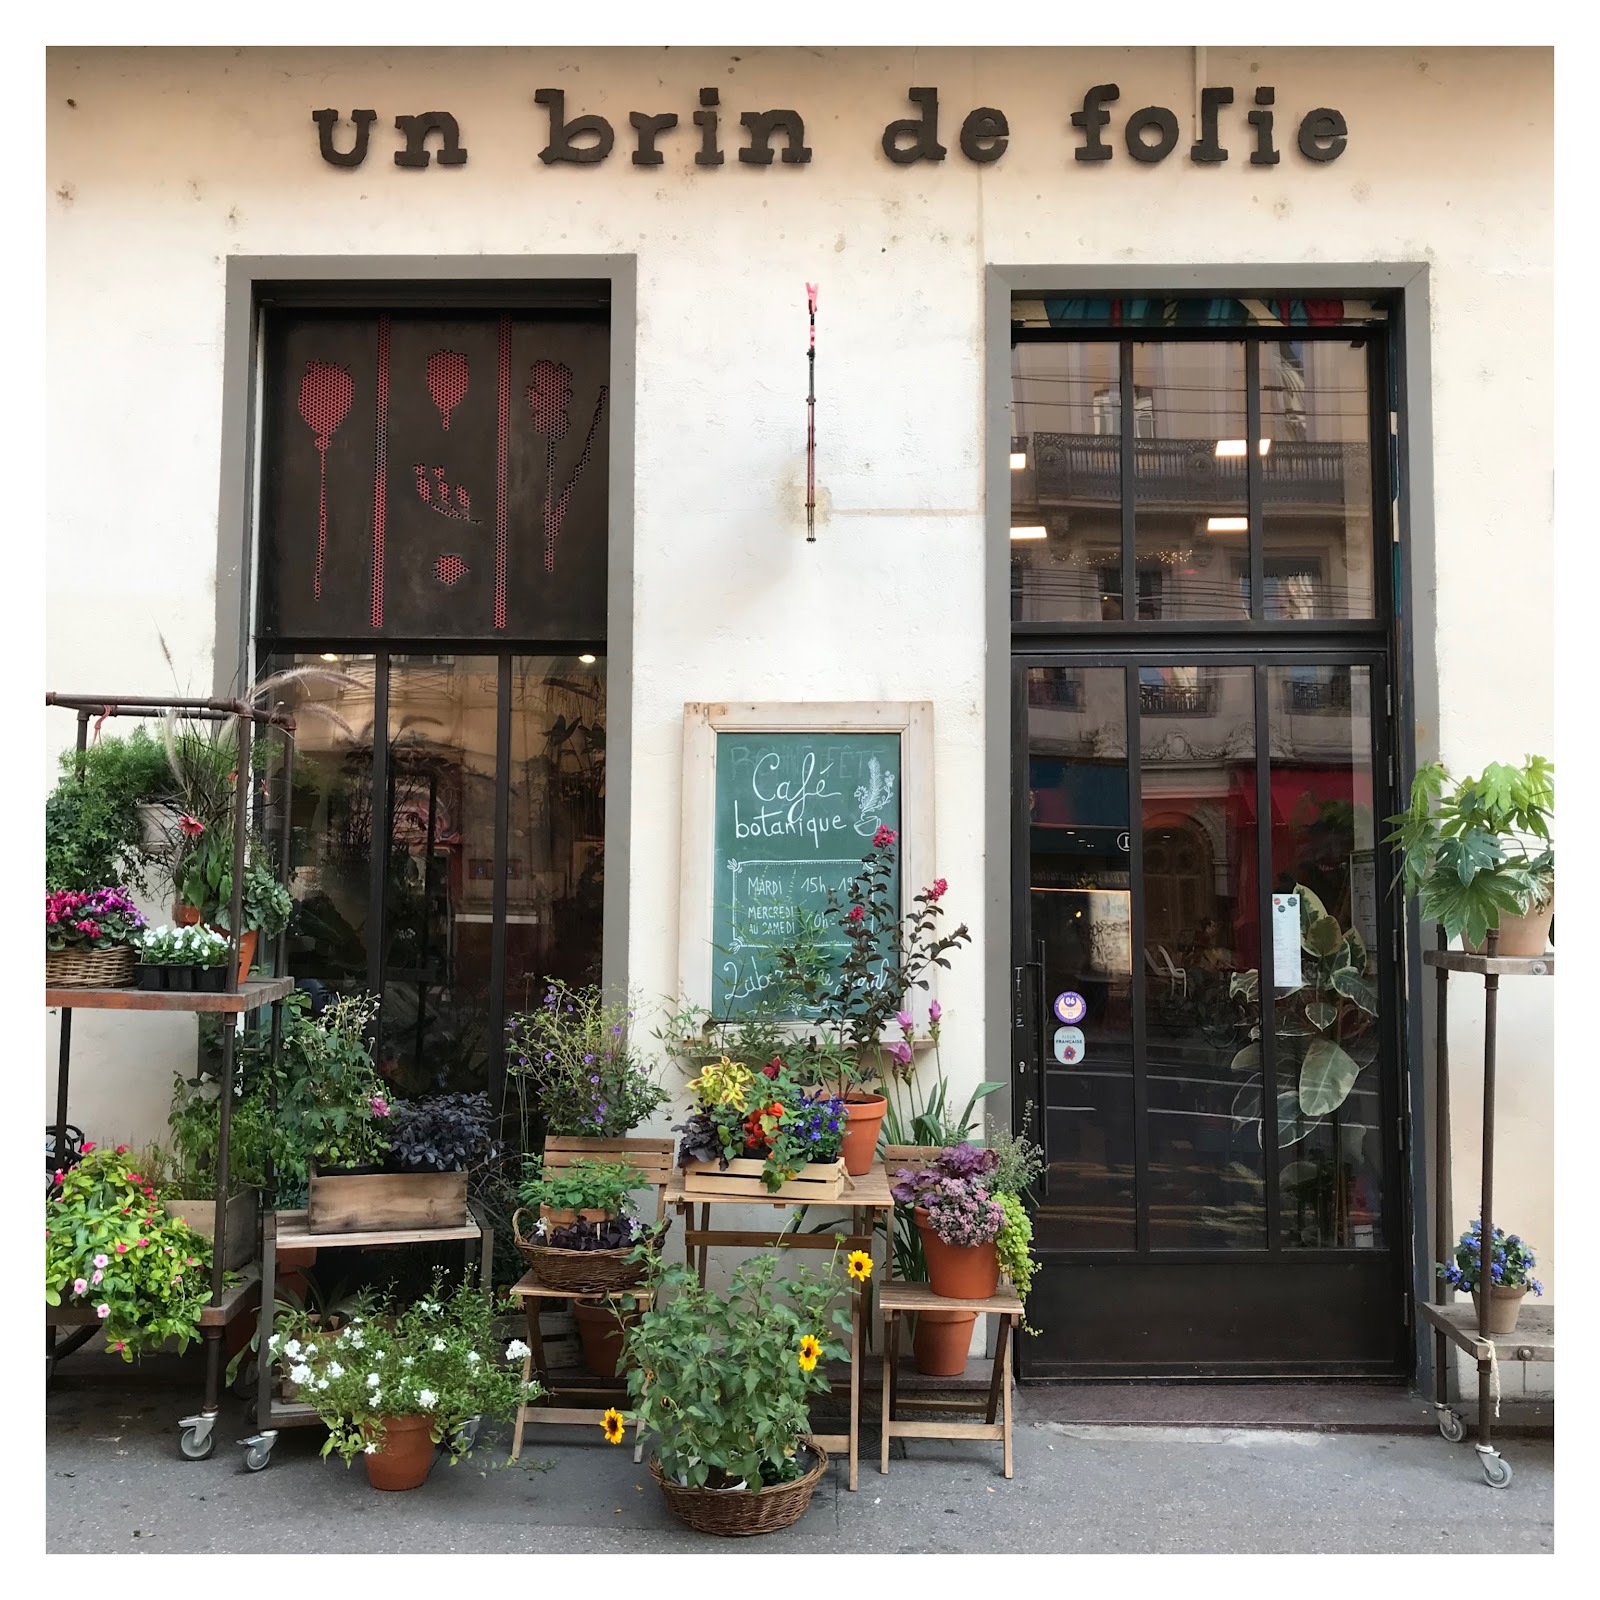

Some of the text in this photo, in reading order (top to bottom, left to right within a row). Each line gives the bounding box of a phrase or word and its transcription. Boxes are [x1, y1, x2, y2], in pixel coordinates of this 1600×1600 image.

[312, 83, 1349, 167] un brin de folie
[752, 752, 842, 824] Café
[734, 799, 847, 849] botanique
[747, 875, 783, 896] MARDI
[800, 875, 827, 893] 15h
[747, 904, 795, 921] MERCREDI
[1065, 996, 1076, 1005] 06
